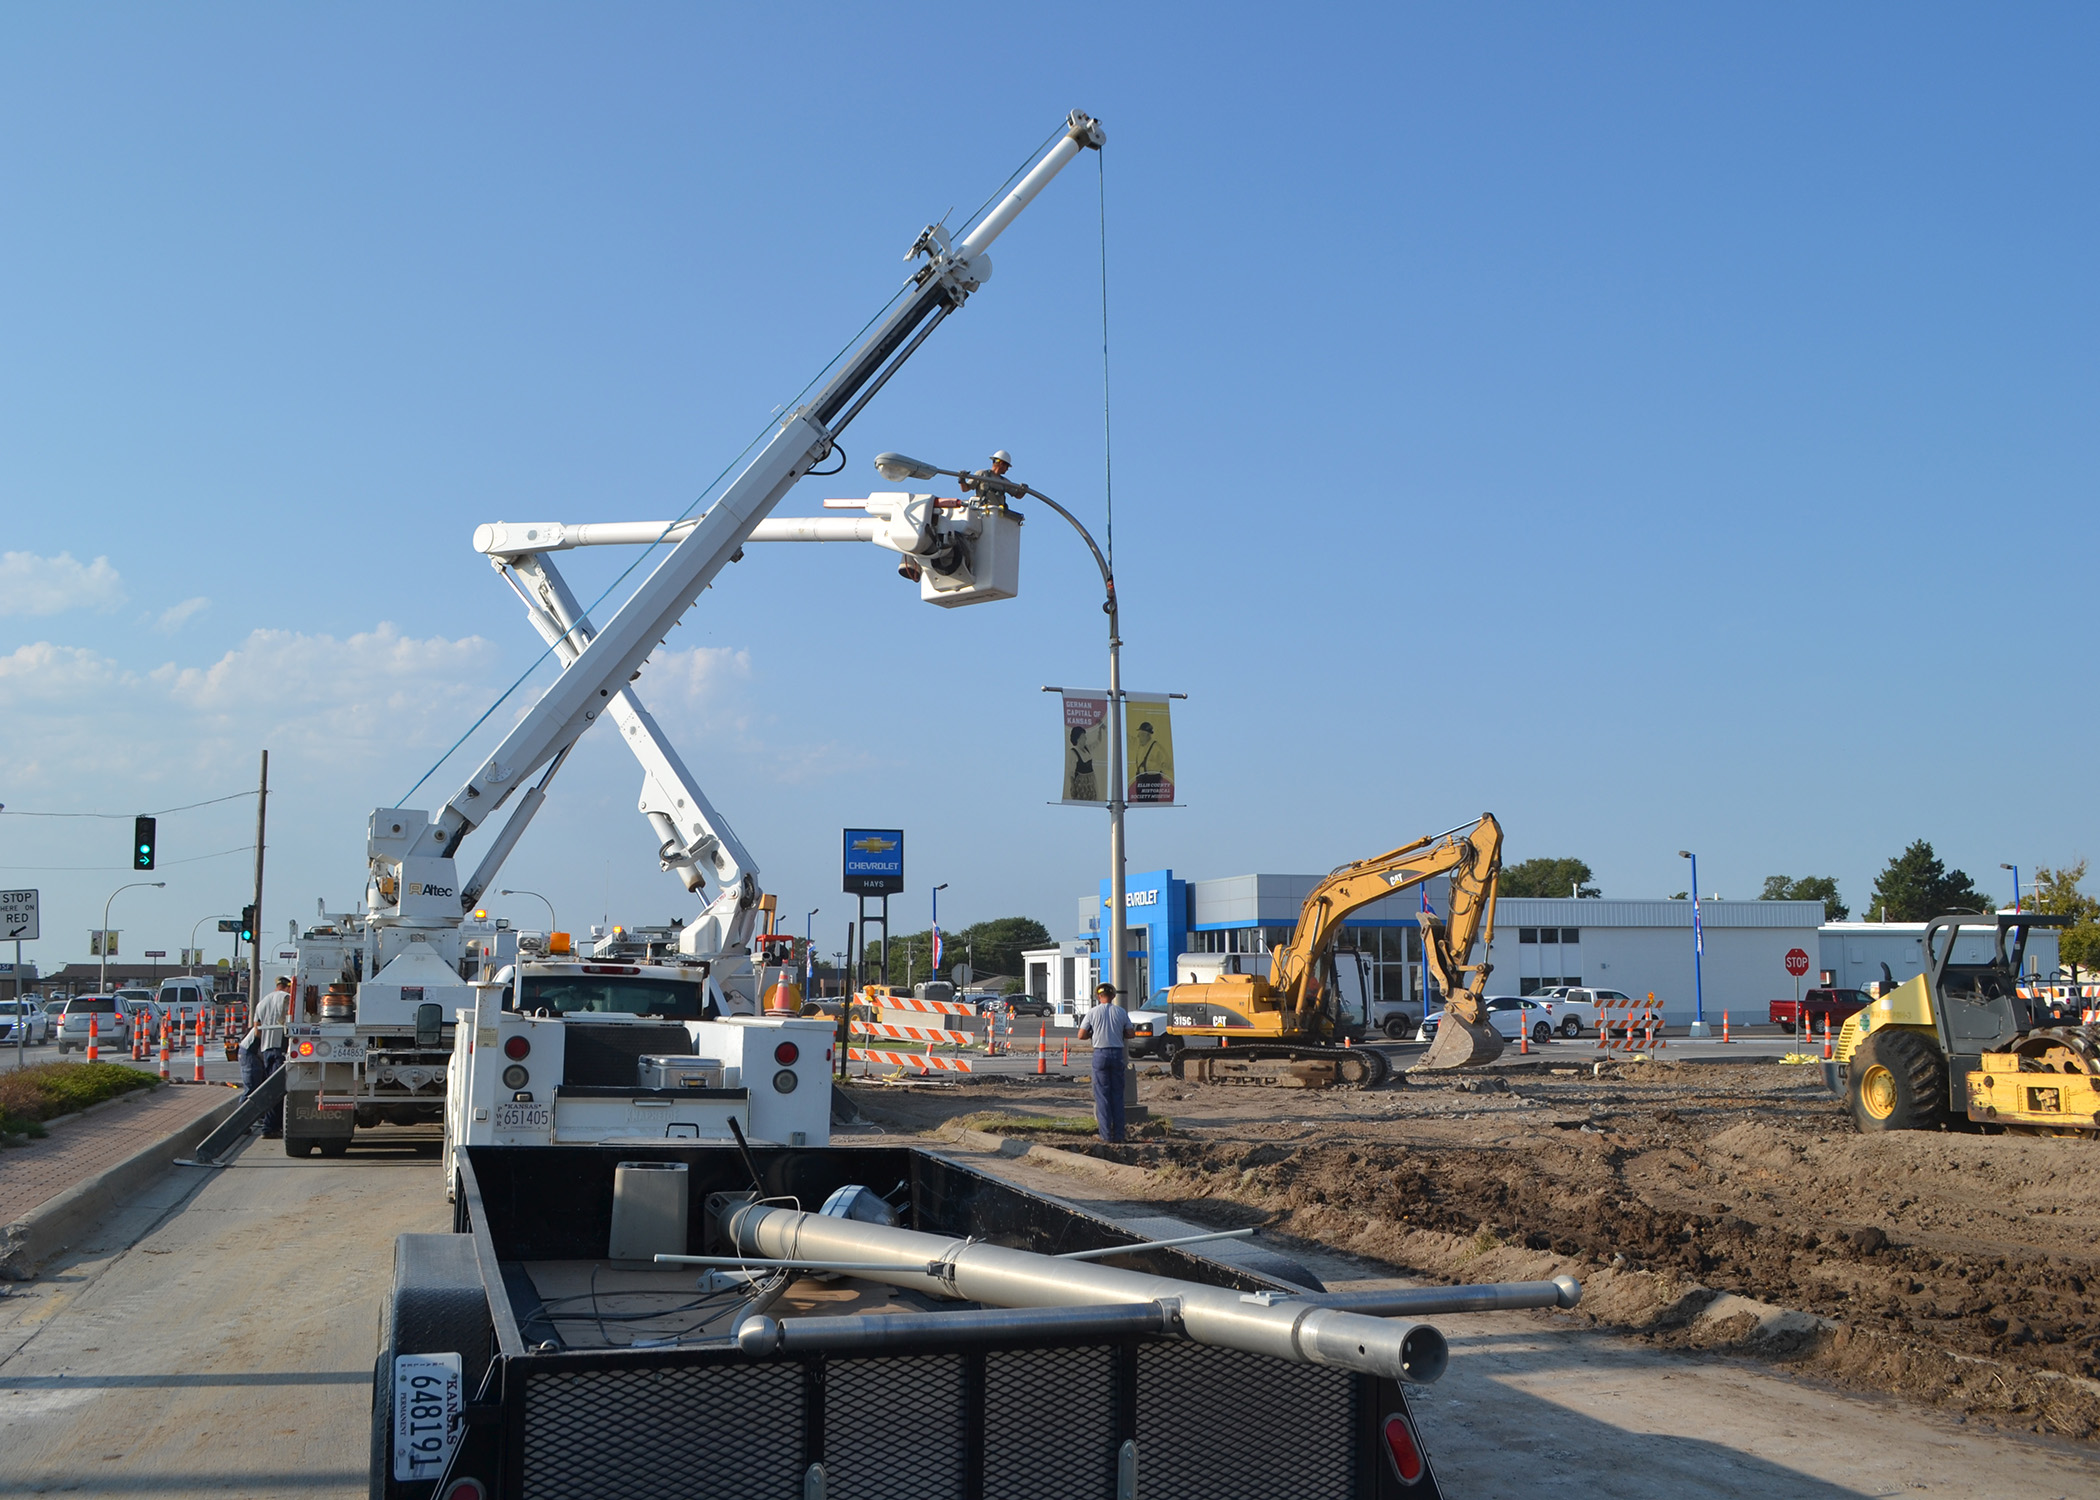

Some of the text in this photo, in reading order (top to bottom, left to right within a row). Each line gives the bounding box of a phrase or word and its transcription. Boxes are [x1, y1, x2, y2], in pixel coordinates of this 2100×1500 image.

[1066, 701, 1092, 709] GERMAN
[1066, 709, 1102, 718] CAPITAL OF
[1067, 717, 1092, 726] KANSAS
[848, 861, 899, 870] CHEVROLET
[863, 880, 884, 888] HAYS
[1390, 873, 1403, 886] CAT
[422, 883, 453, 897] Altec
[3, 893, 32, 903] STOP
[1125, 889, 1159, 908] EVROLET
[0, 904, 18, 912] HERE
[6, 913, 29, 924] RED
[1786, 956, 1808, 968] STOP
[1173, 1016, 1192, 1026] 315C
[1212, 1015, 1227, 1028] CAT
[504, 1110, 549, 1125] 651405
[411, 1376, 442, 1469] 648191
